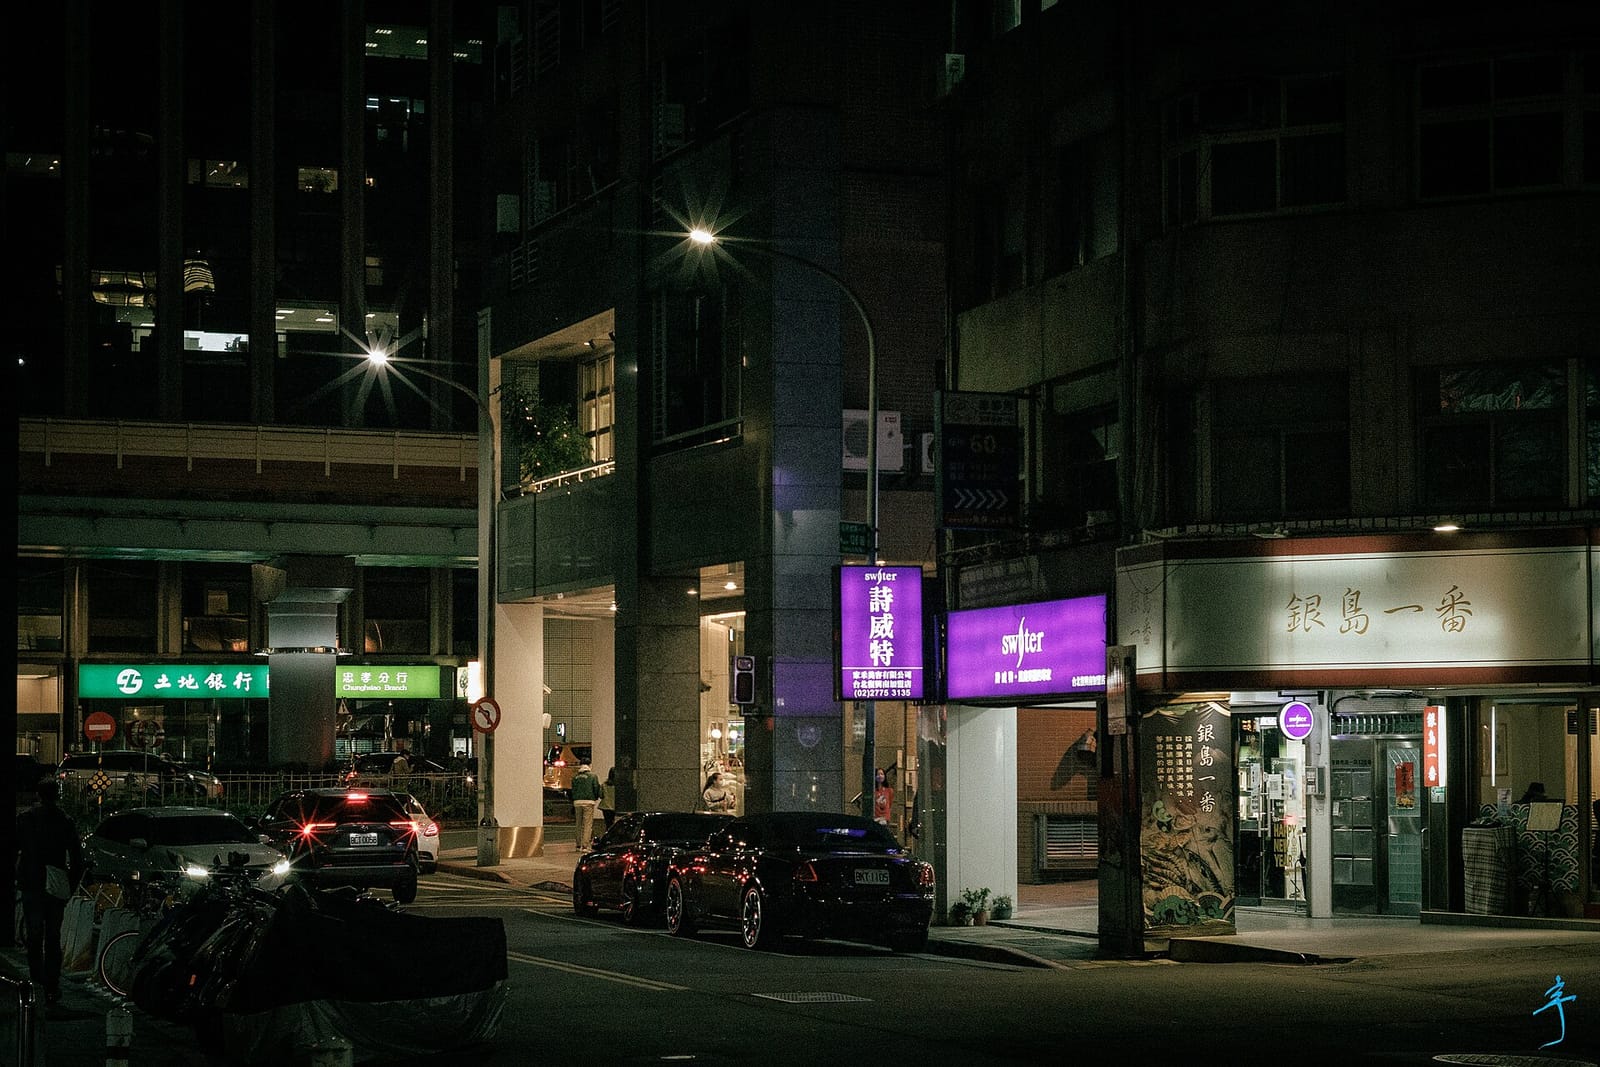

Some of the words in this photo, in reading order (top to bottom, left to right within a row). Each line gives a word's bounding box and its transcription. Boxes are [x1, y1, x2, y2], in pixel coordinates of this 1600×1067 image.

[1286, 585, 1473, 635] 銀島一番
[869, 586, 894, 667] 詩威特
[154, 671, 253, 691] 土地銀行
[343, 672, 408, 684] 忠孝分行
[384, 684, 408, 692] Branch
[854, 689, 889, 698] (02)2775
[891, 689, 911, 697] 3135
[1197, 724, 1216, 813] 銀島一番
[1274, 823, 1297, 837] HAPPY
[1274, 854, 1293, 868] YEAR
